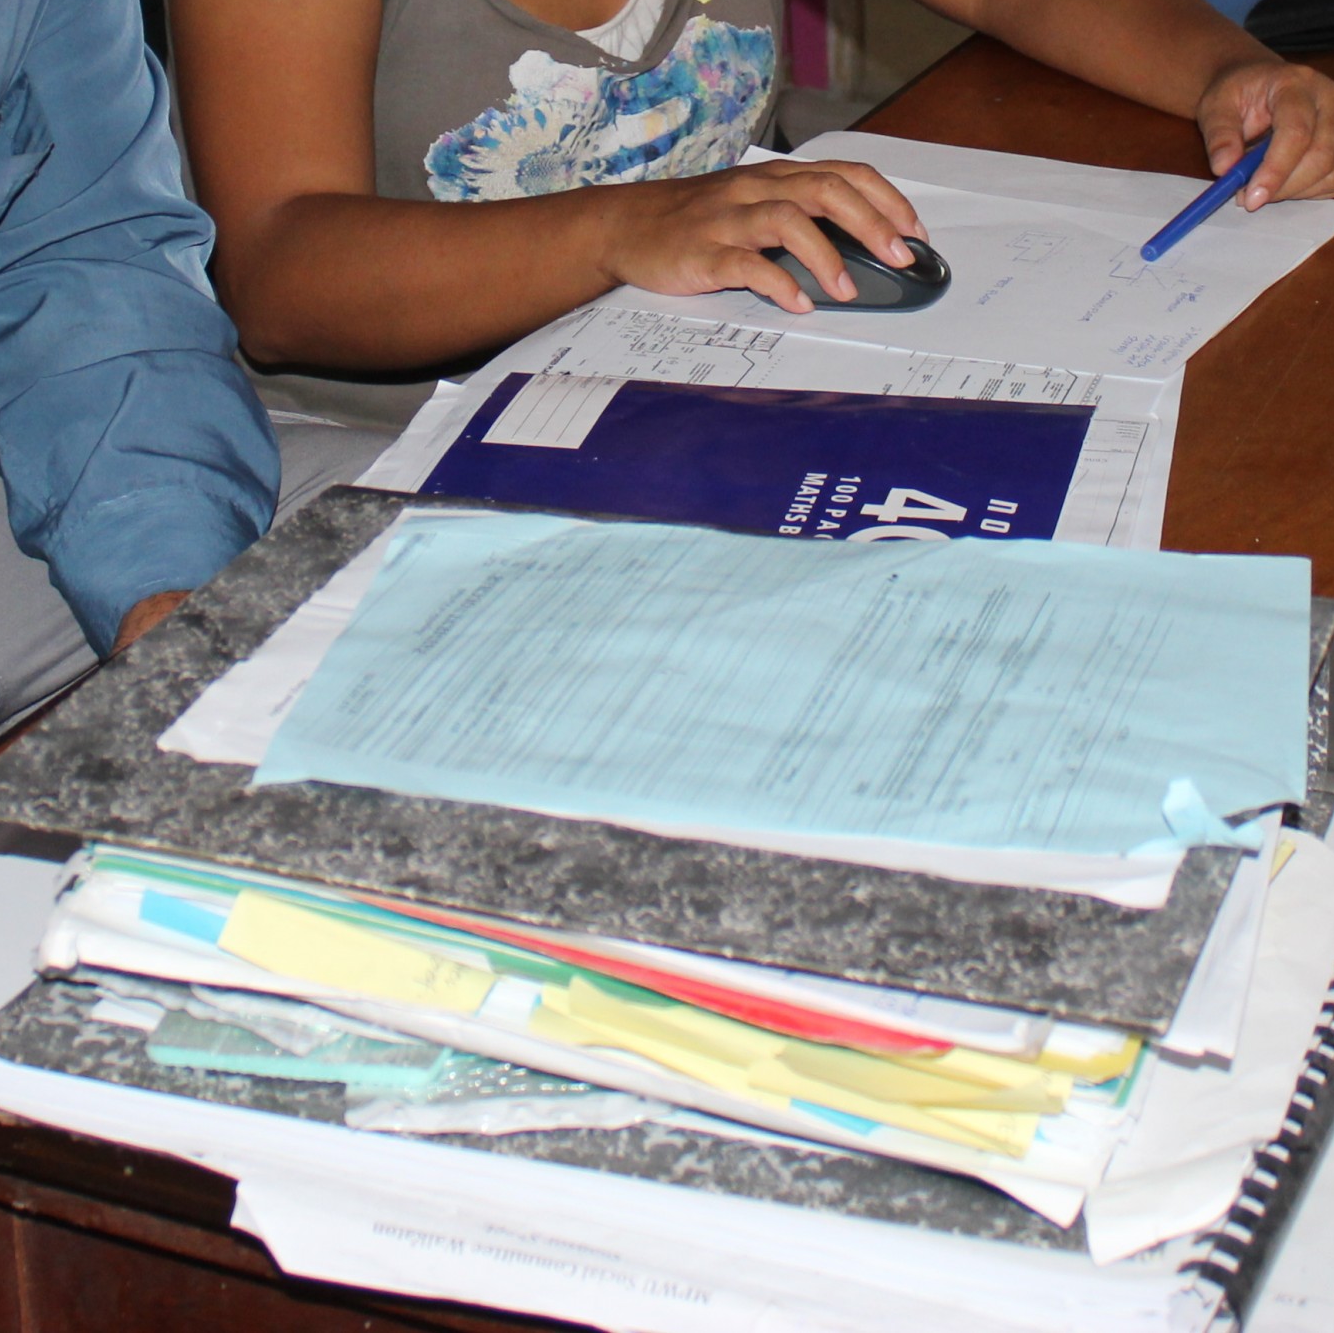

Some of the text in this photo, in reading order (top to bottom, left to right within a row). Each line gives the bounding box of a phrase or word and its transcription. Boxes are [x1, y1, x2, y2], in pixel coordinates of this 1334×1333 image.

[784, 472, 828, 523] MATHS
[813, 476, 861, 540] 100 PA
[980, 499, 1018, 534] no
[470, 1241, 579, 1278] Committee
[581, 1265, 637, 1290] Social
